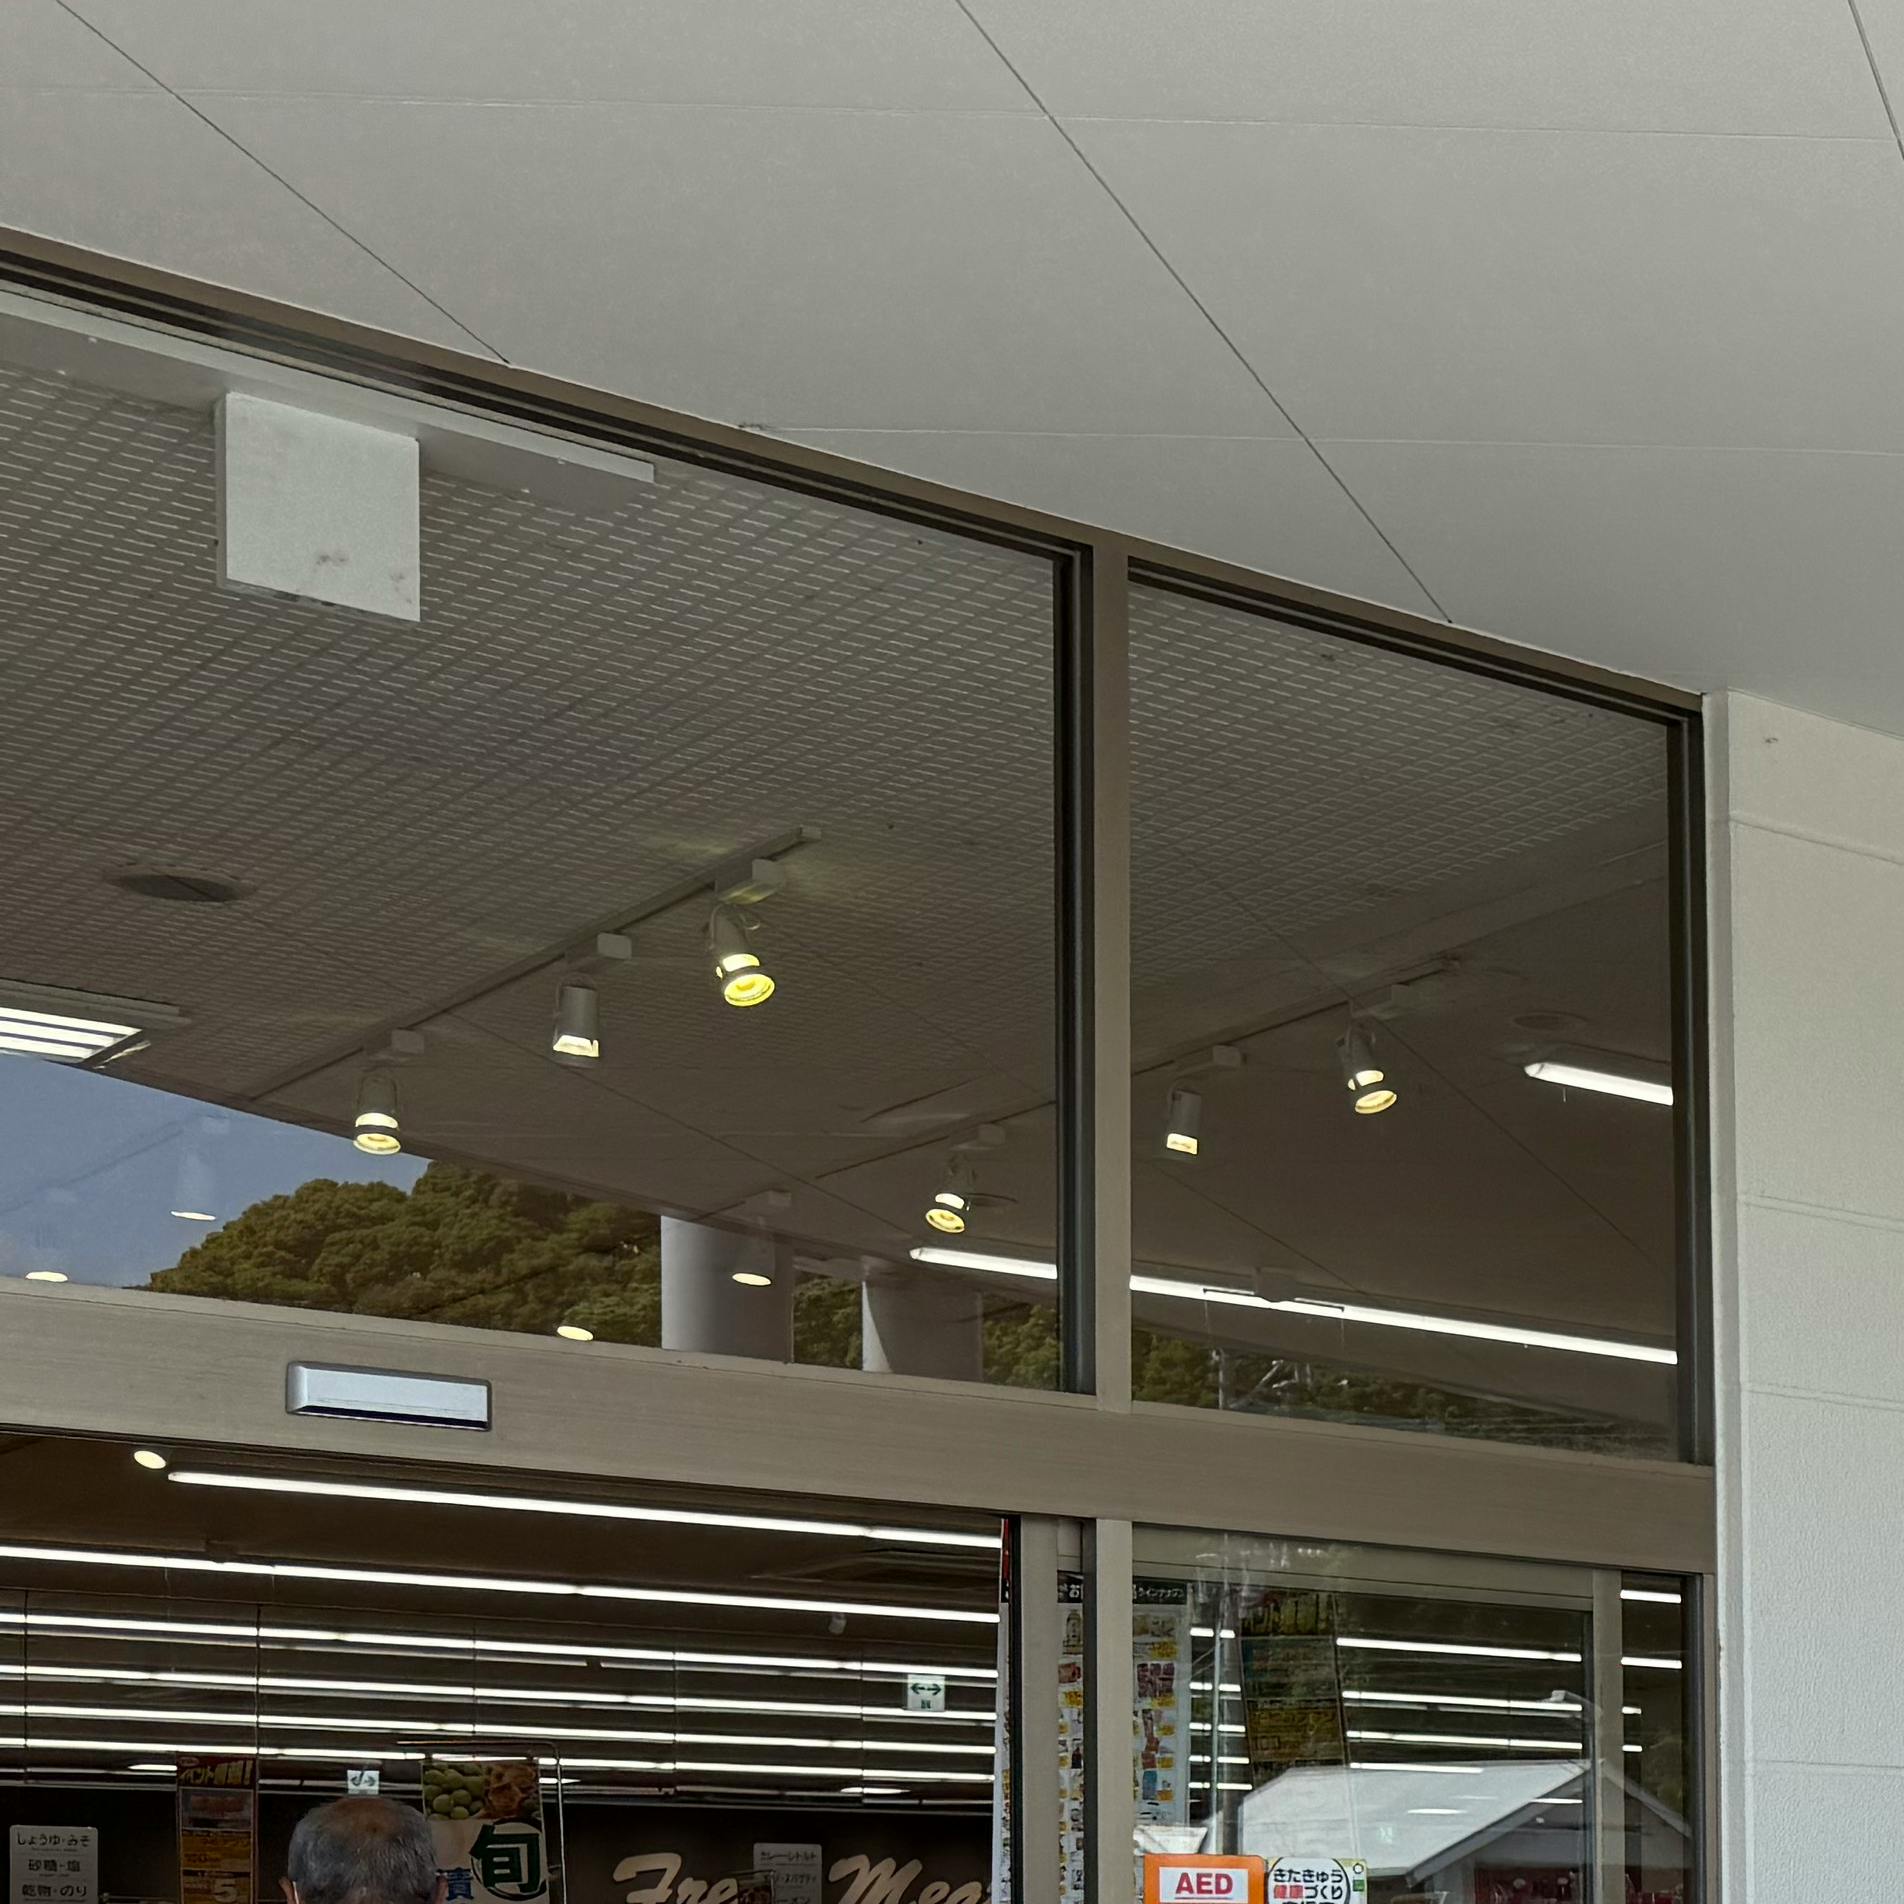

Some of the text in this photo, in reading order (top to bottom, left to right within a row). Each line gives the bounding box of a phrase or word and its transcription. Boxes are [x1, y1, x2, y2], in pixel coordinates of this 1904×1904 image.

[17, 1832, 91, 1847] しょうゆ・みそ
[1273, 1868, 1344, 1883] きたきゅう
[1175, 1872, 1234, 1895] AED
[1273, 1884, 1344, 1900] 健康づくり
